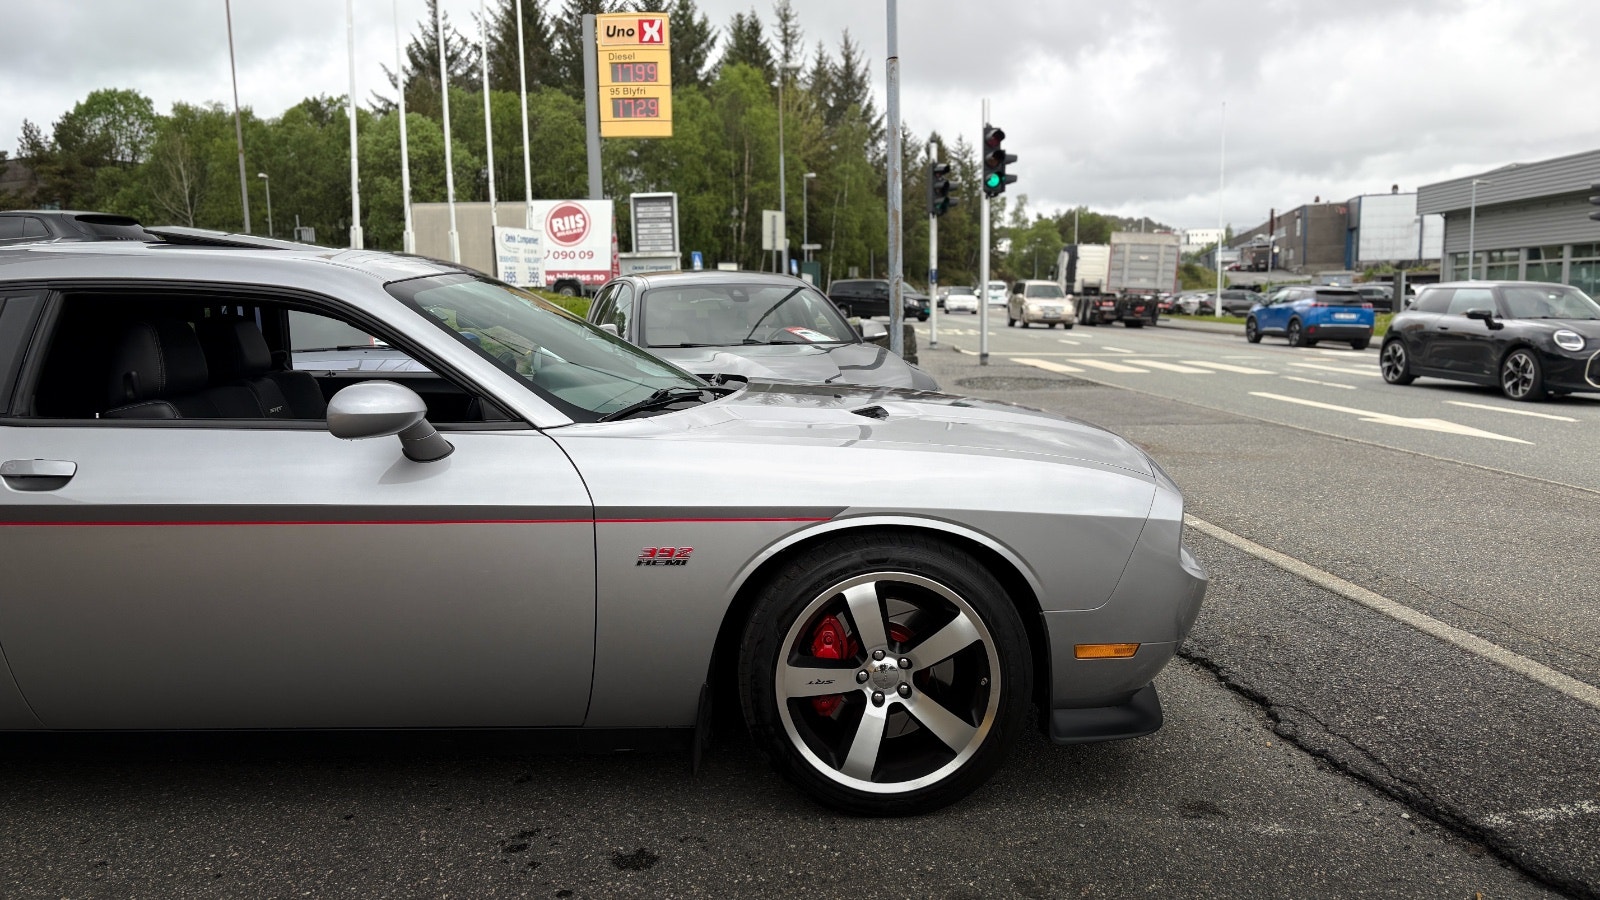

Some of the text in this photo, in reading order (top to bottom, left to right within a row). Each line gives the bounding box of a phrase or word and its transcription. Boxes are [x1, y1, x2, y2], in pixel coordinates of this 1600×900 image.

[606, 19, 662, 42] Uno X
[608, 52, 635, 61] Diesel
[610, 87, 646, 97] 95 Blyfri
[551, 213, 585, 233] RIIS
[552, 250, 594, 260] 090 09
[638, 546, 694, 559] 392
